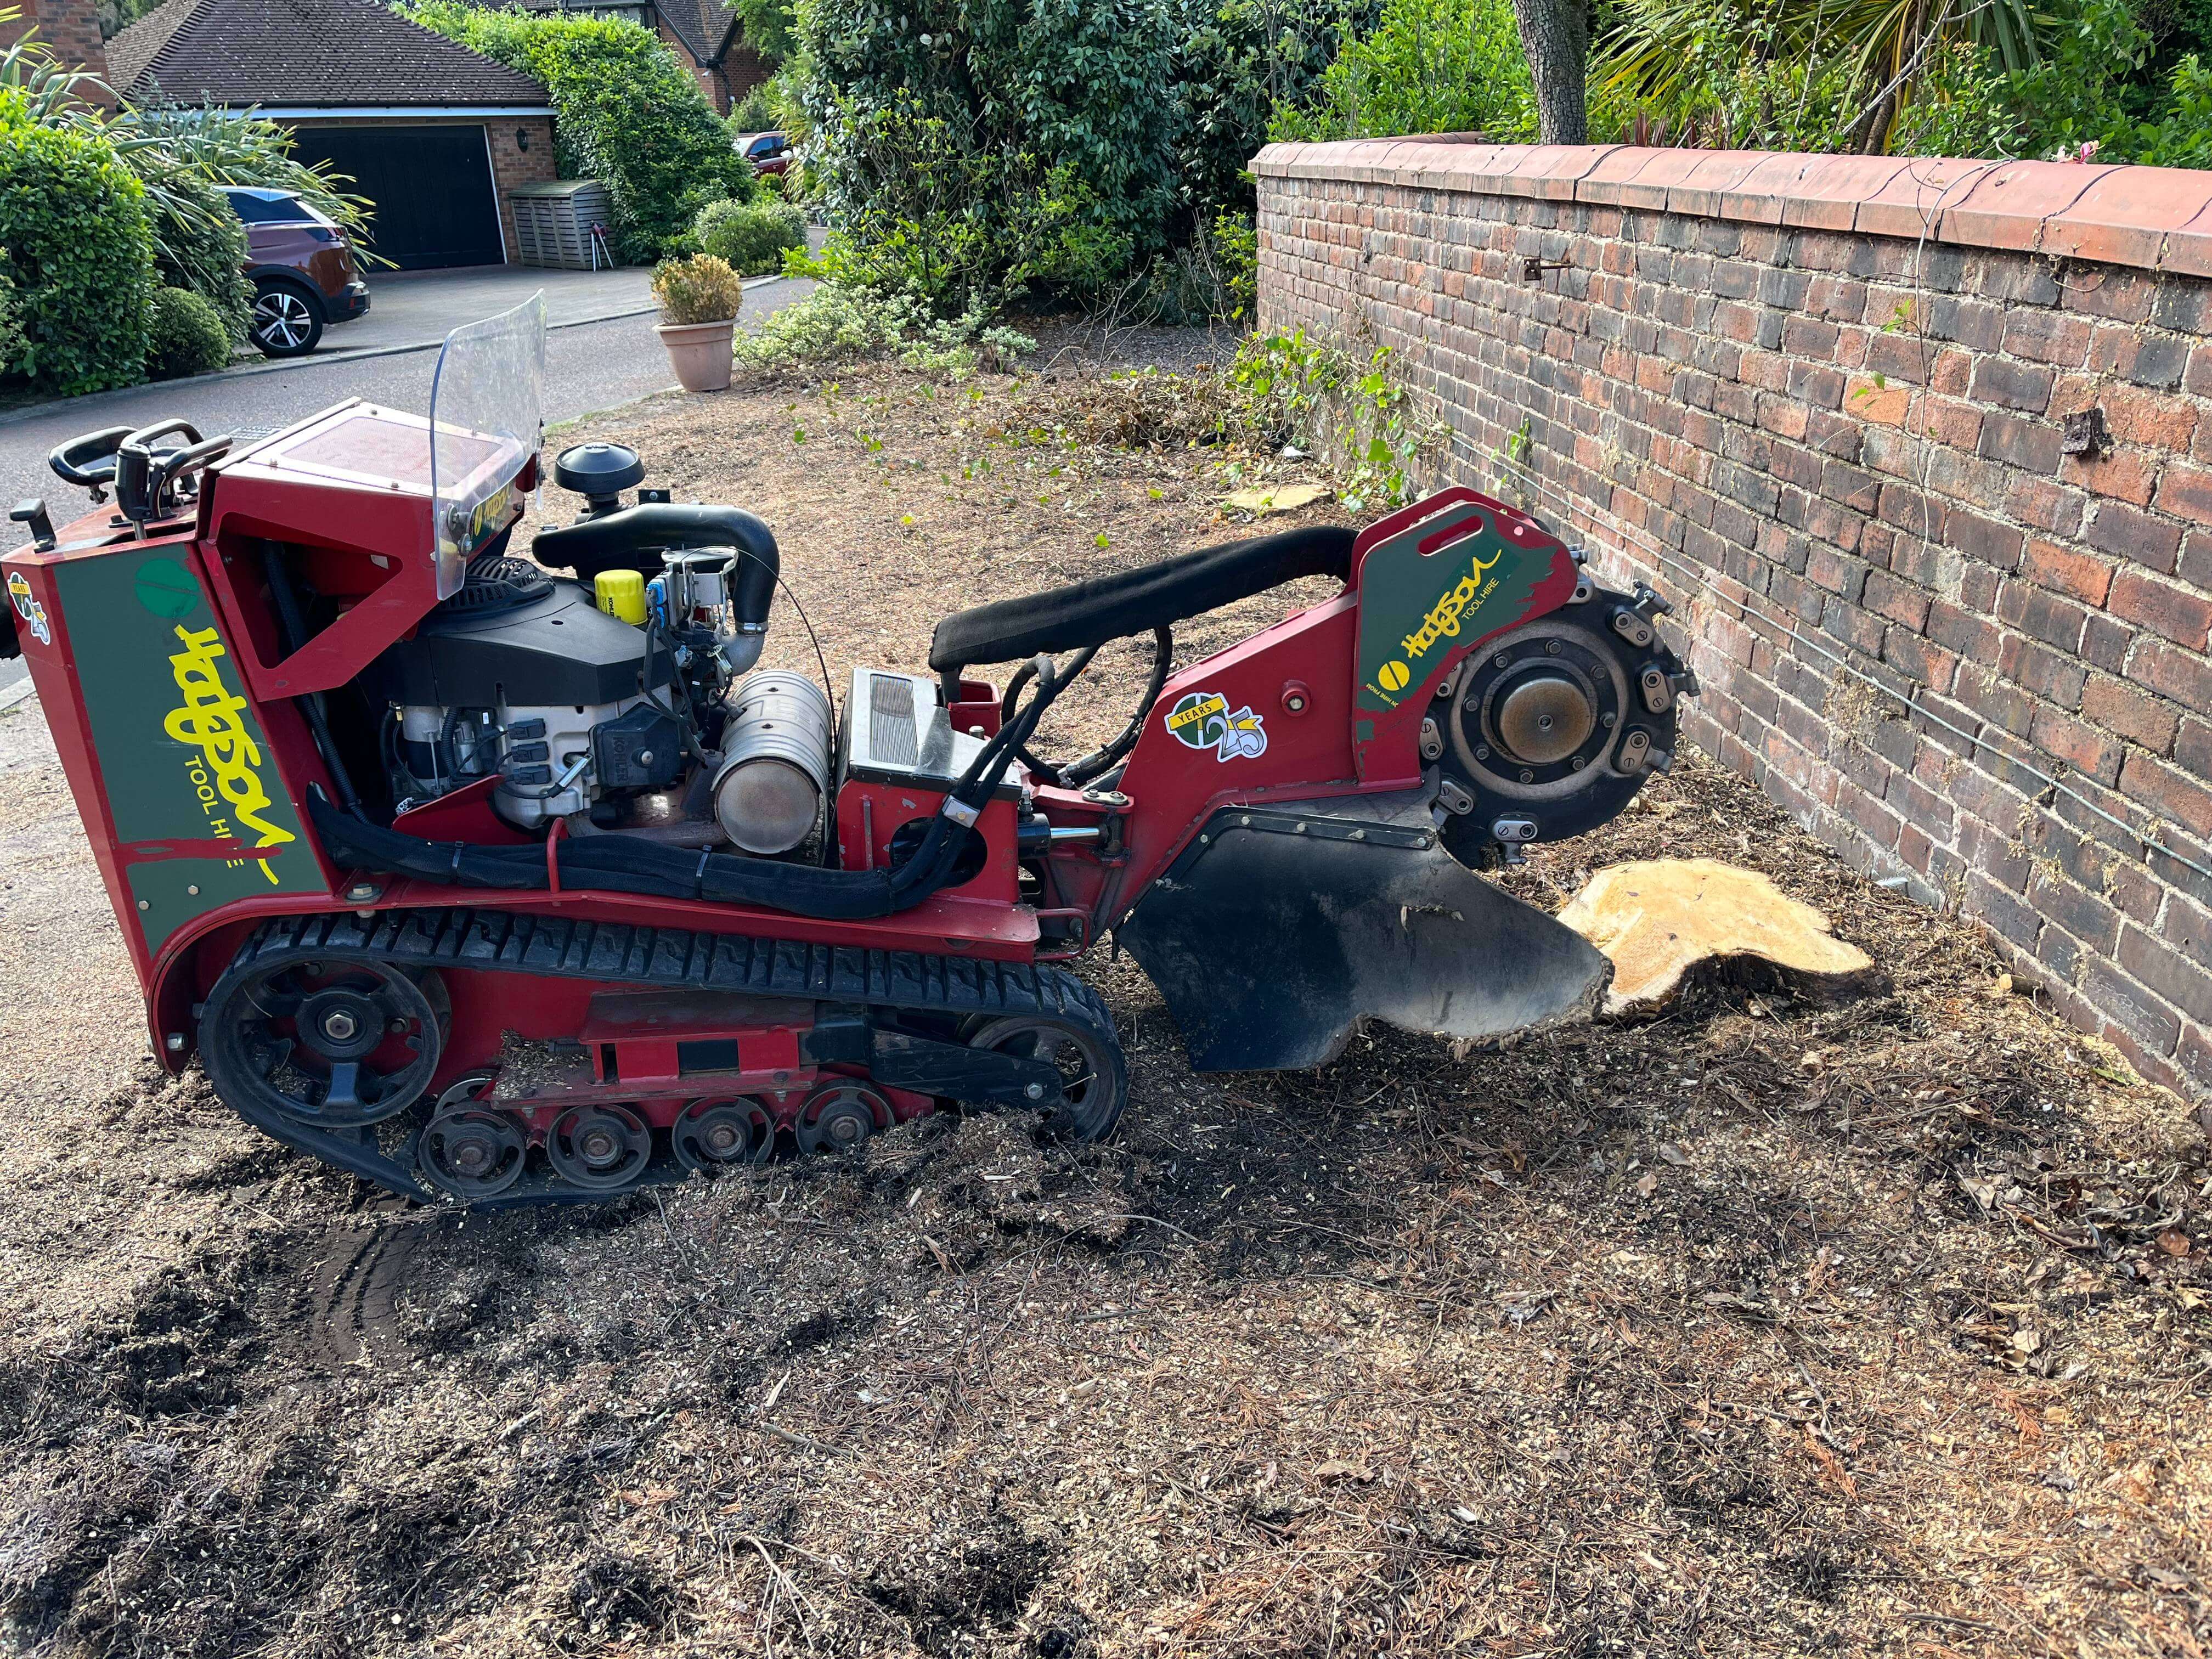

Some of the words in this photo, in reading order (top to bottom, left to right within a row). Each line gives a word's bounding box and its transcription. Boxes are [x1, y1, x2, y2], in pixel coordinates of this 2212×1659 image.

[13, 584, 25, 592] YEARS
[1401, 549, 1502, 658] Hodgson
[1462, 599, 1484, 619] TOOL
[1480, 577, 1499, 599] HIRE
[1366, 683, 1381, 695] FROM
[1379, 693, 1392, 703] HIRE
[1178, 704, 1212, 723] YEARS
[1206, 709, 1264, 759] 25
[165, 624, 296, 885] Hodgson
[613, 737, 629, 782] KOHLER
[184, 755, 218, 815] TOOL
[210, 819, 244, 868] HIE
